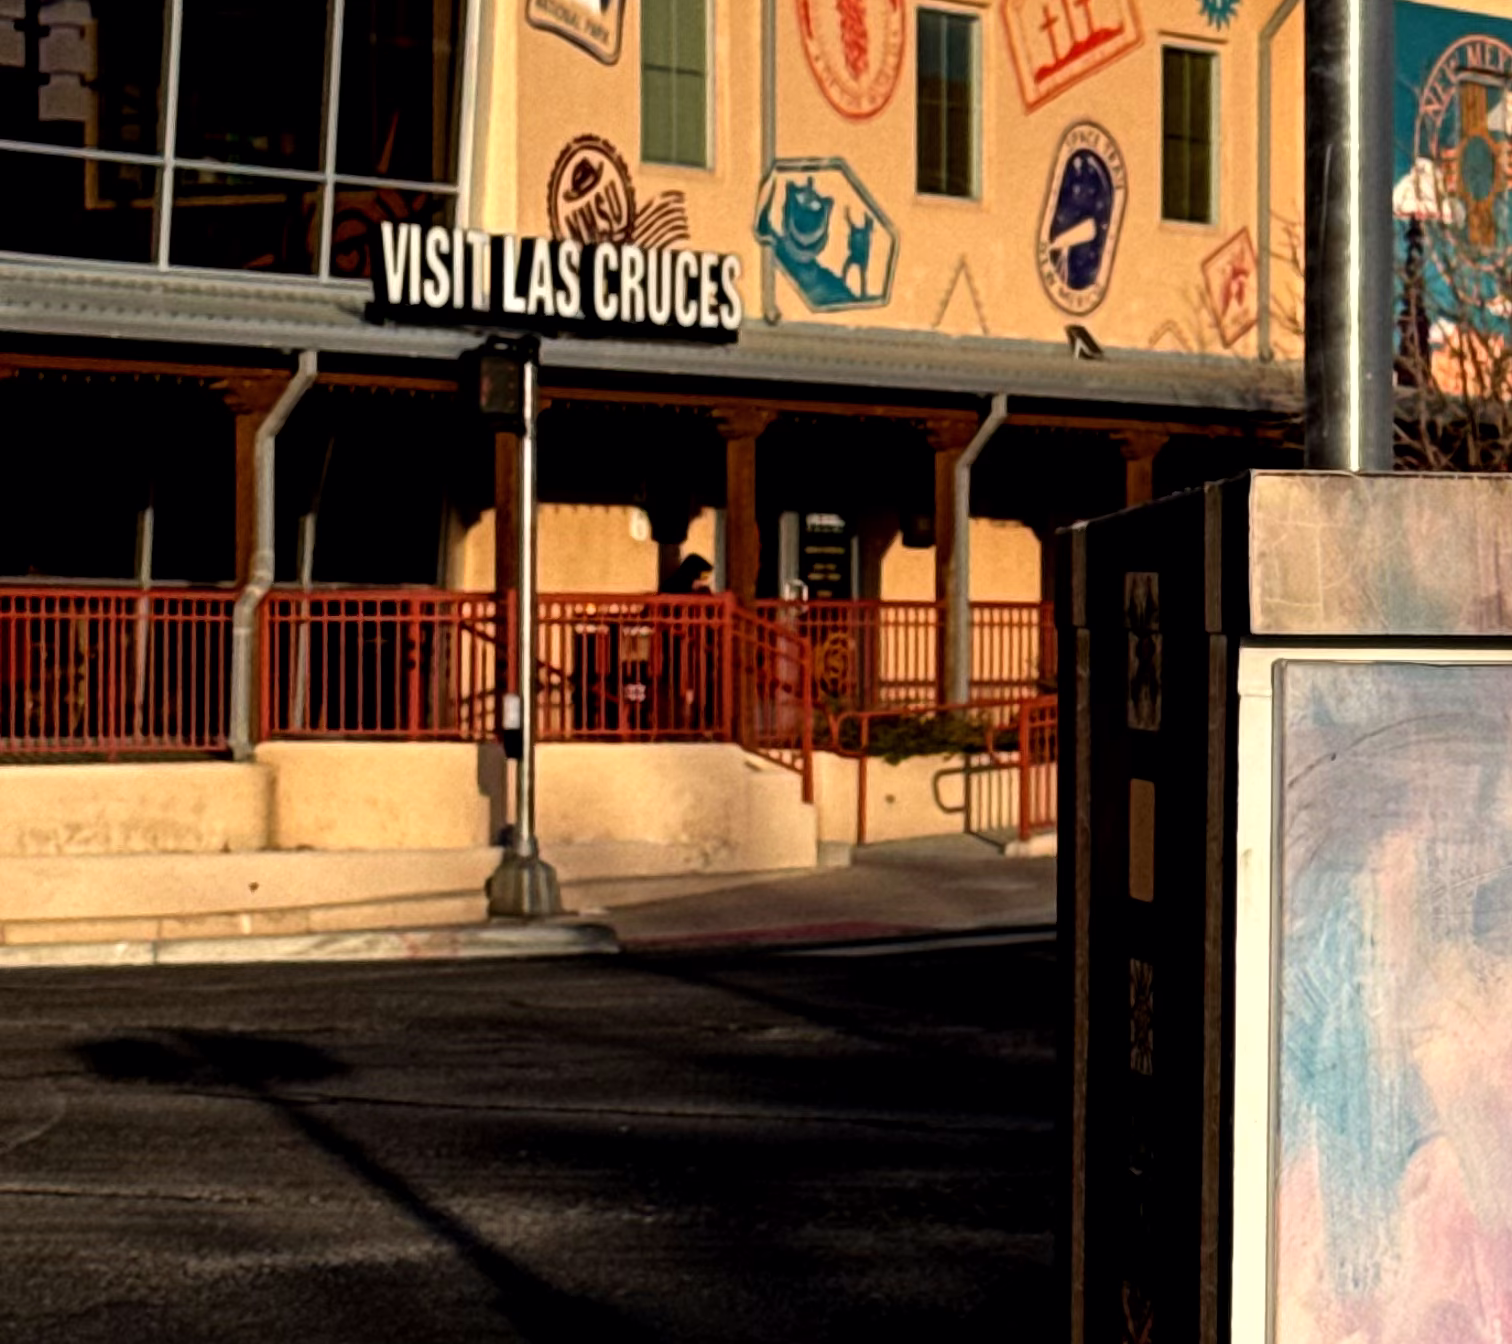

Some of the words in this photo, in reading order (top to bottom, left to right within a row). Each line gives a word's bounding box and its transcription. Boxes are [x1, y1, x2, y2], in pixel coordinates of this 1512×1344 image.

[564, 179, 623, 244] NMSU
[381, 220, 491, 312] VISIT
[502, 233, 582, 318] LAS
[593, 242, 743, 331] CRUCES
